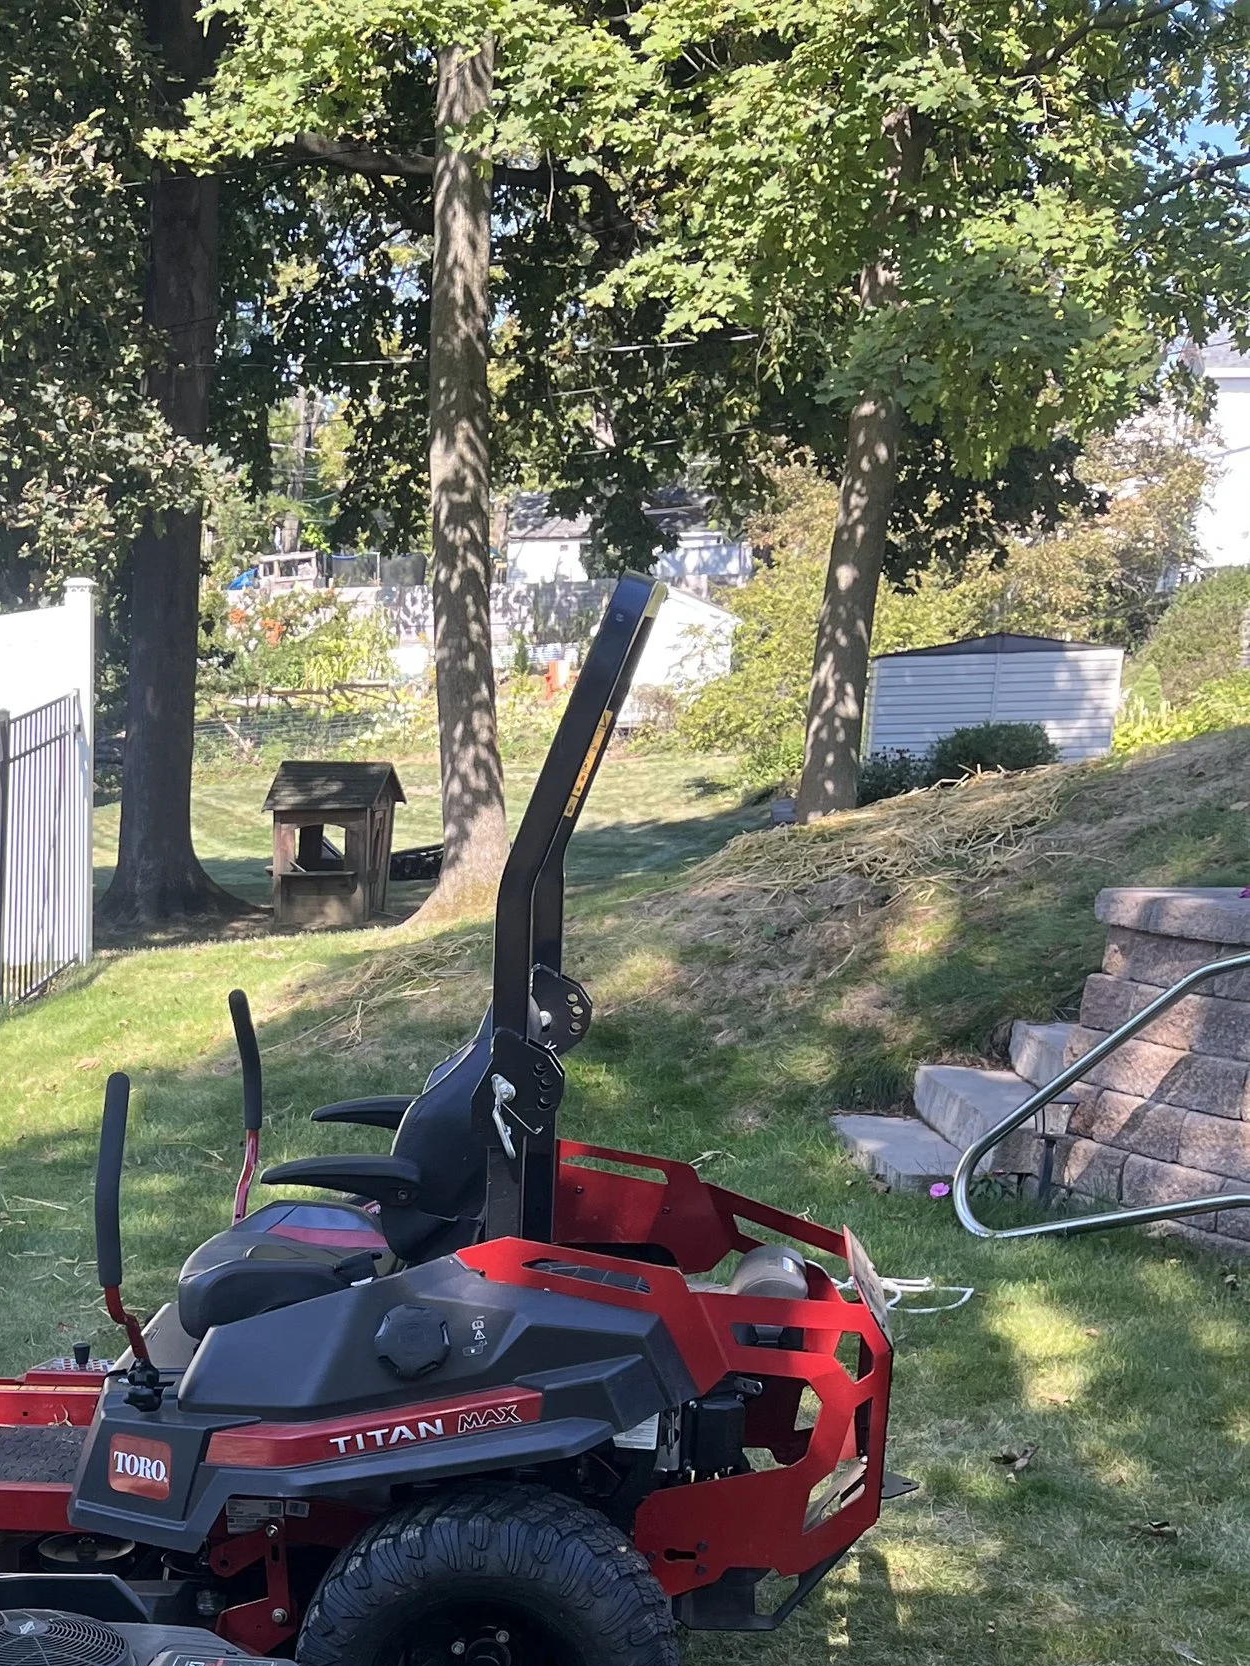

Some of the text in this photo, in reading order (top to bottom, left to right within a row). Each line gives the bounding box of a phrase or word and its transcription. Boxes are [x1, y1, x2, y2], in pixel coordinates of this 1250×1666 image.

[329, 1405, 522, 1454] TITAN MAX
[113, 1450, 167, 1482] TORO
